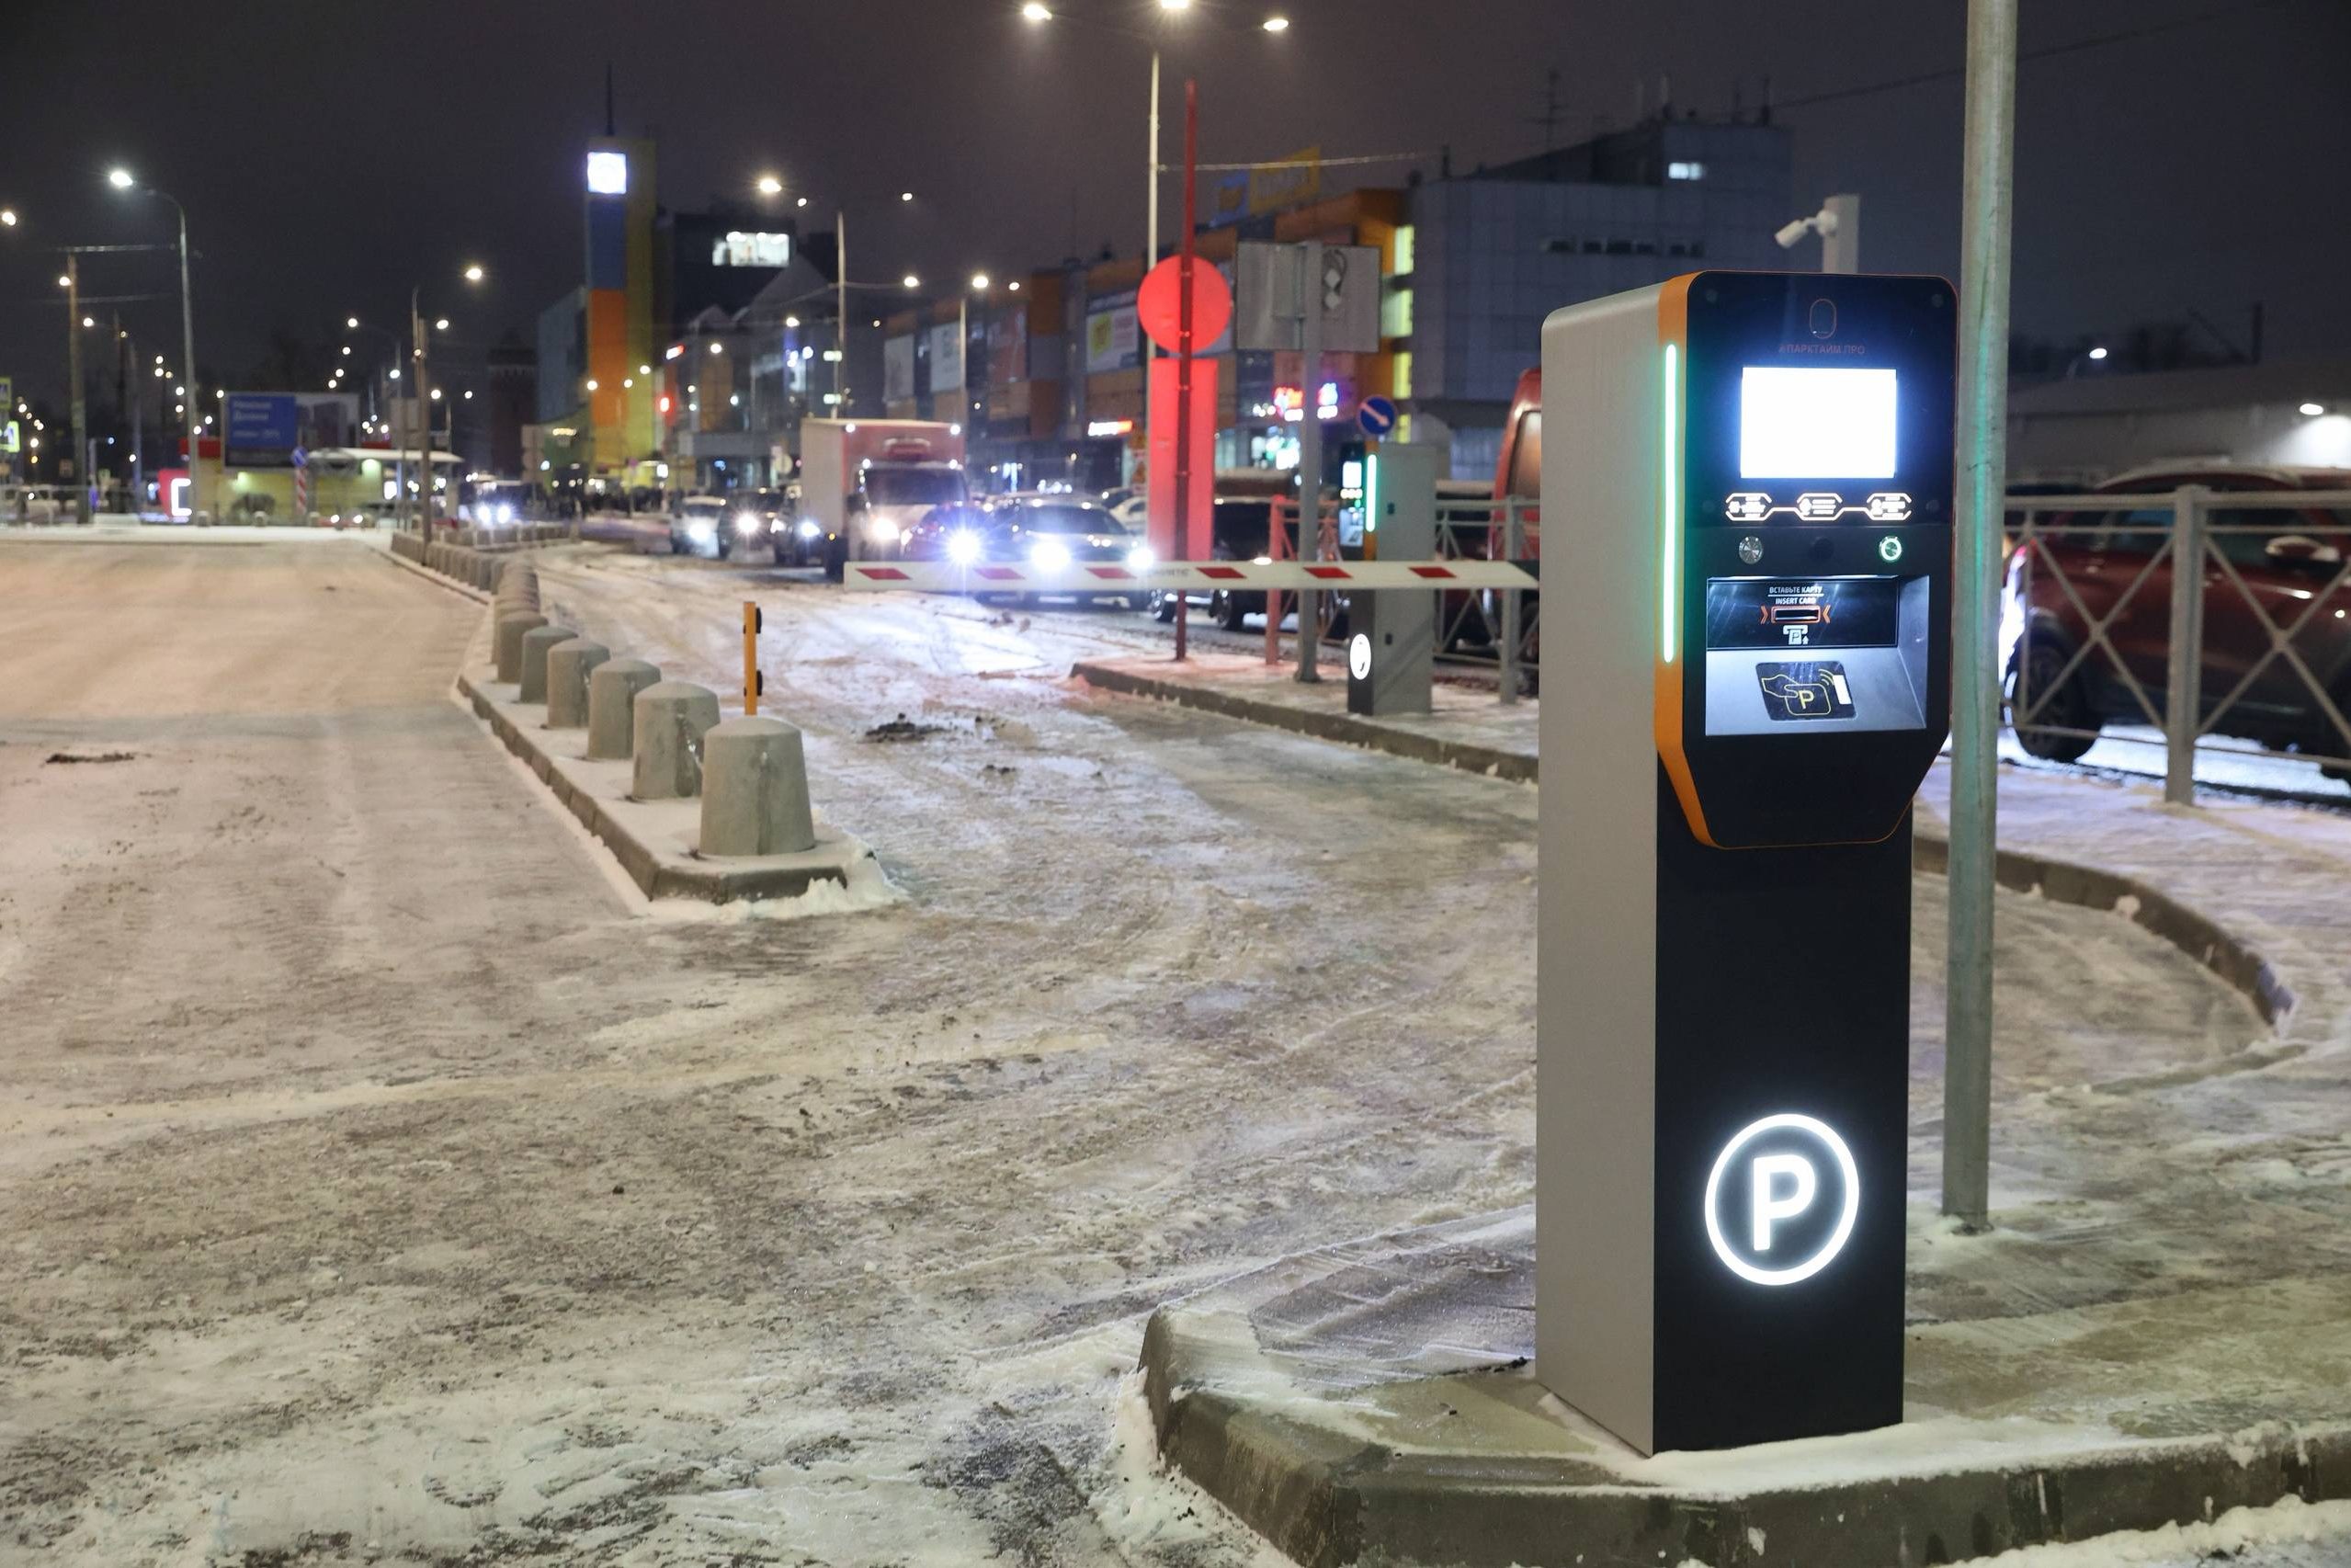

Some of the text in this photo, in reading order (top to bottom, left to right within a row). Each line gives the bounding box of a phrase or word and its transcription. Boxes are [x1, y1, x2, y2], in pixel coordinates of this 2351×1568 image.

[1801, 585, 1823, 594] КАРТУ
[1798, 689, 1815, 710] P
[1754, 1153, 1816, 1252] P
